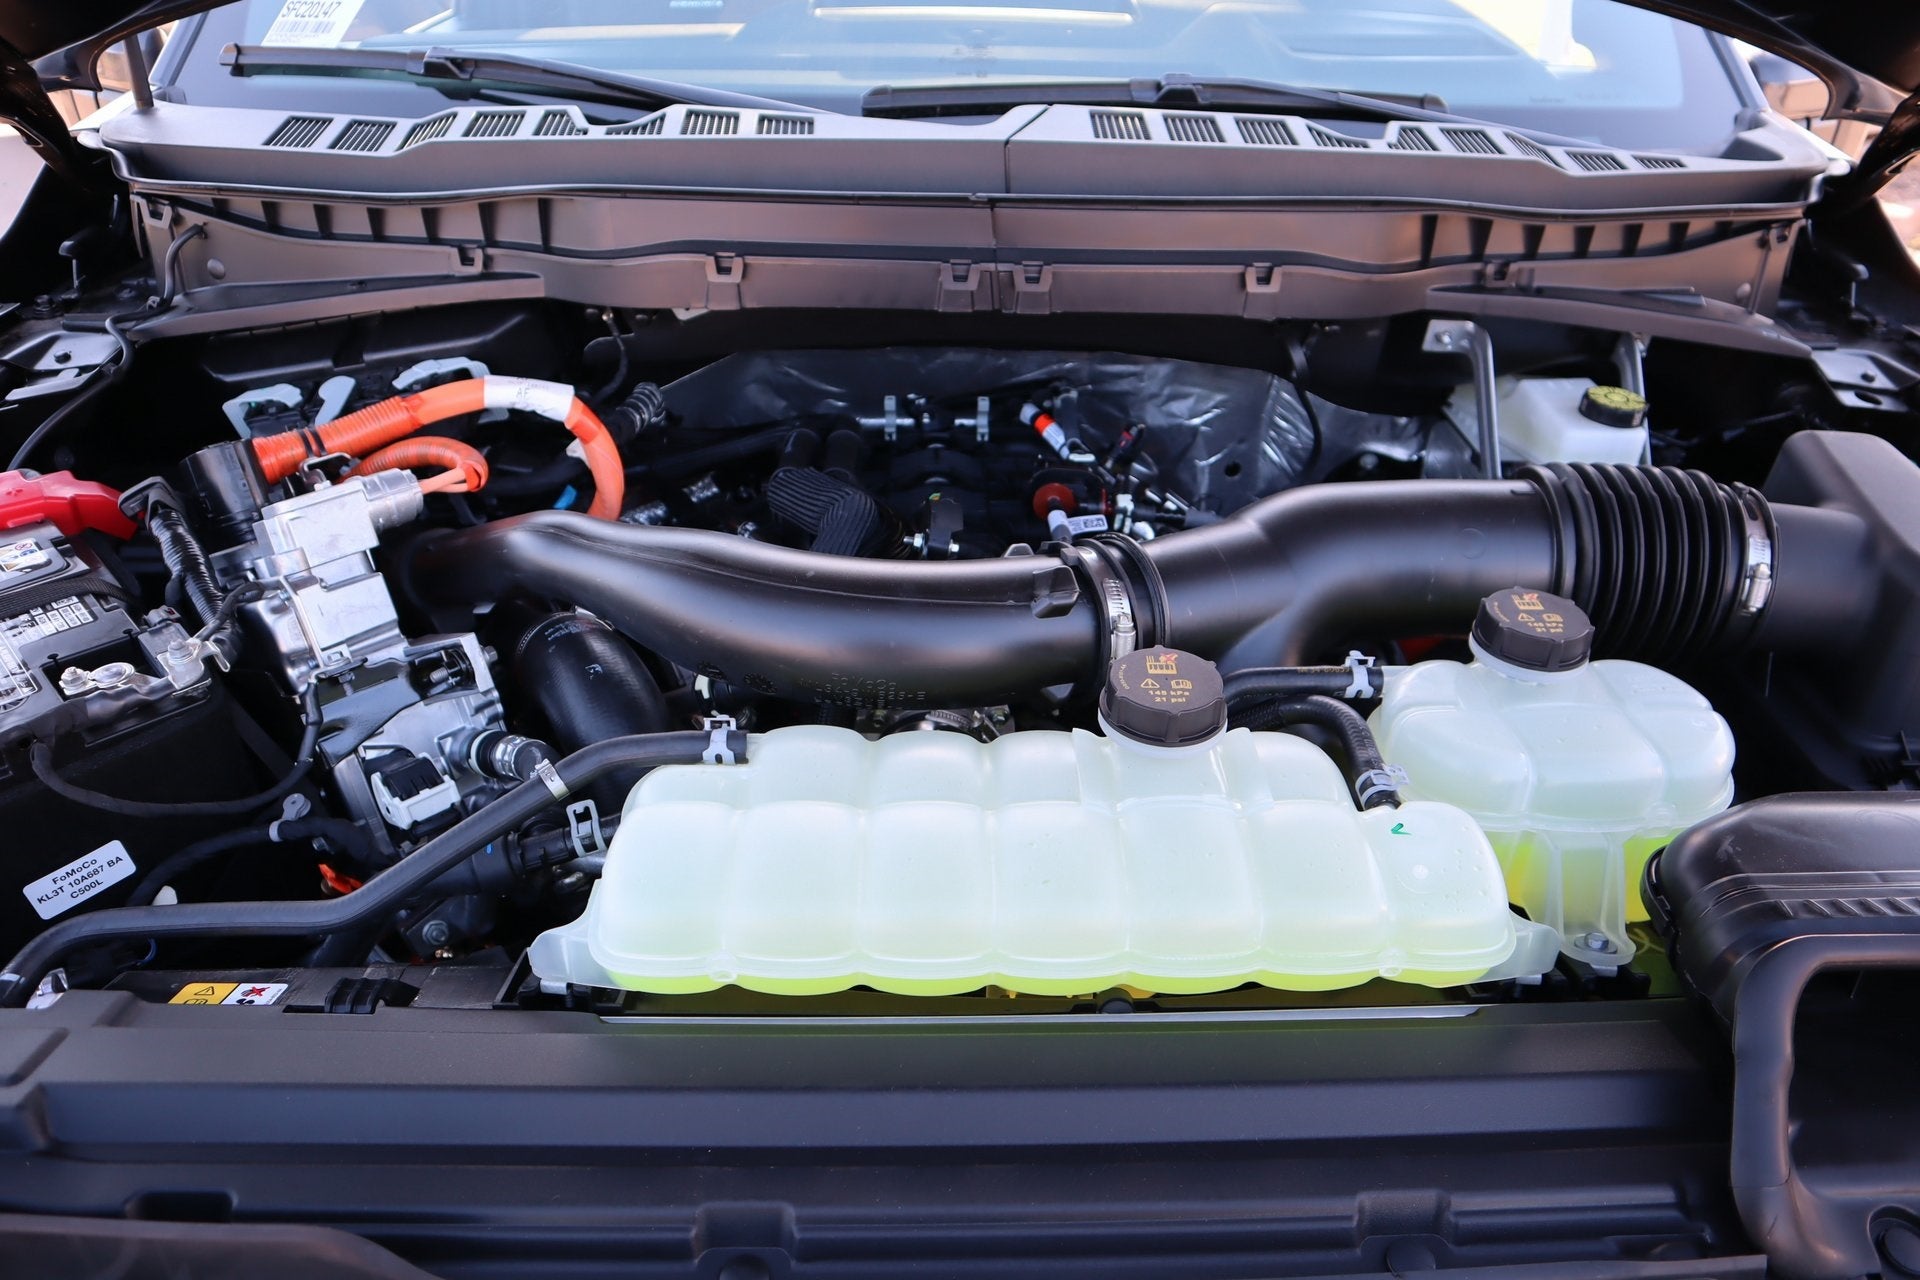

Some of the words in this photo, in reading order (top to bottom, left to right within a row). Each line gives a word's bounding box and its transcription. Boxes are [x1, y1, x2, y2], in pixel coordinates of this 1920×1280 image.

[281, 1, 342, 18] SFC20147
[37, 885, 65, 905] KL3T
[68, 865, 105, 889] 10A687
[107, 856, 123, 868] BA
[52, 858, 98, 885] FoMoCo
[70, 879, 104, 899] C500L
